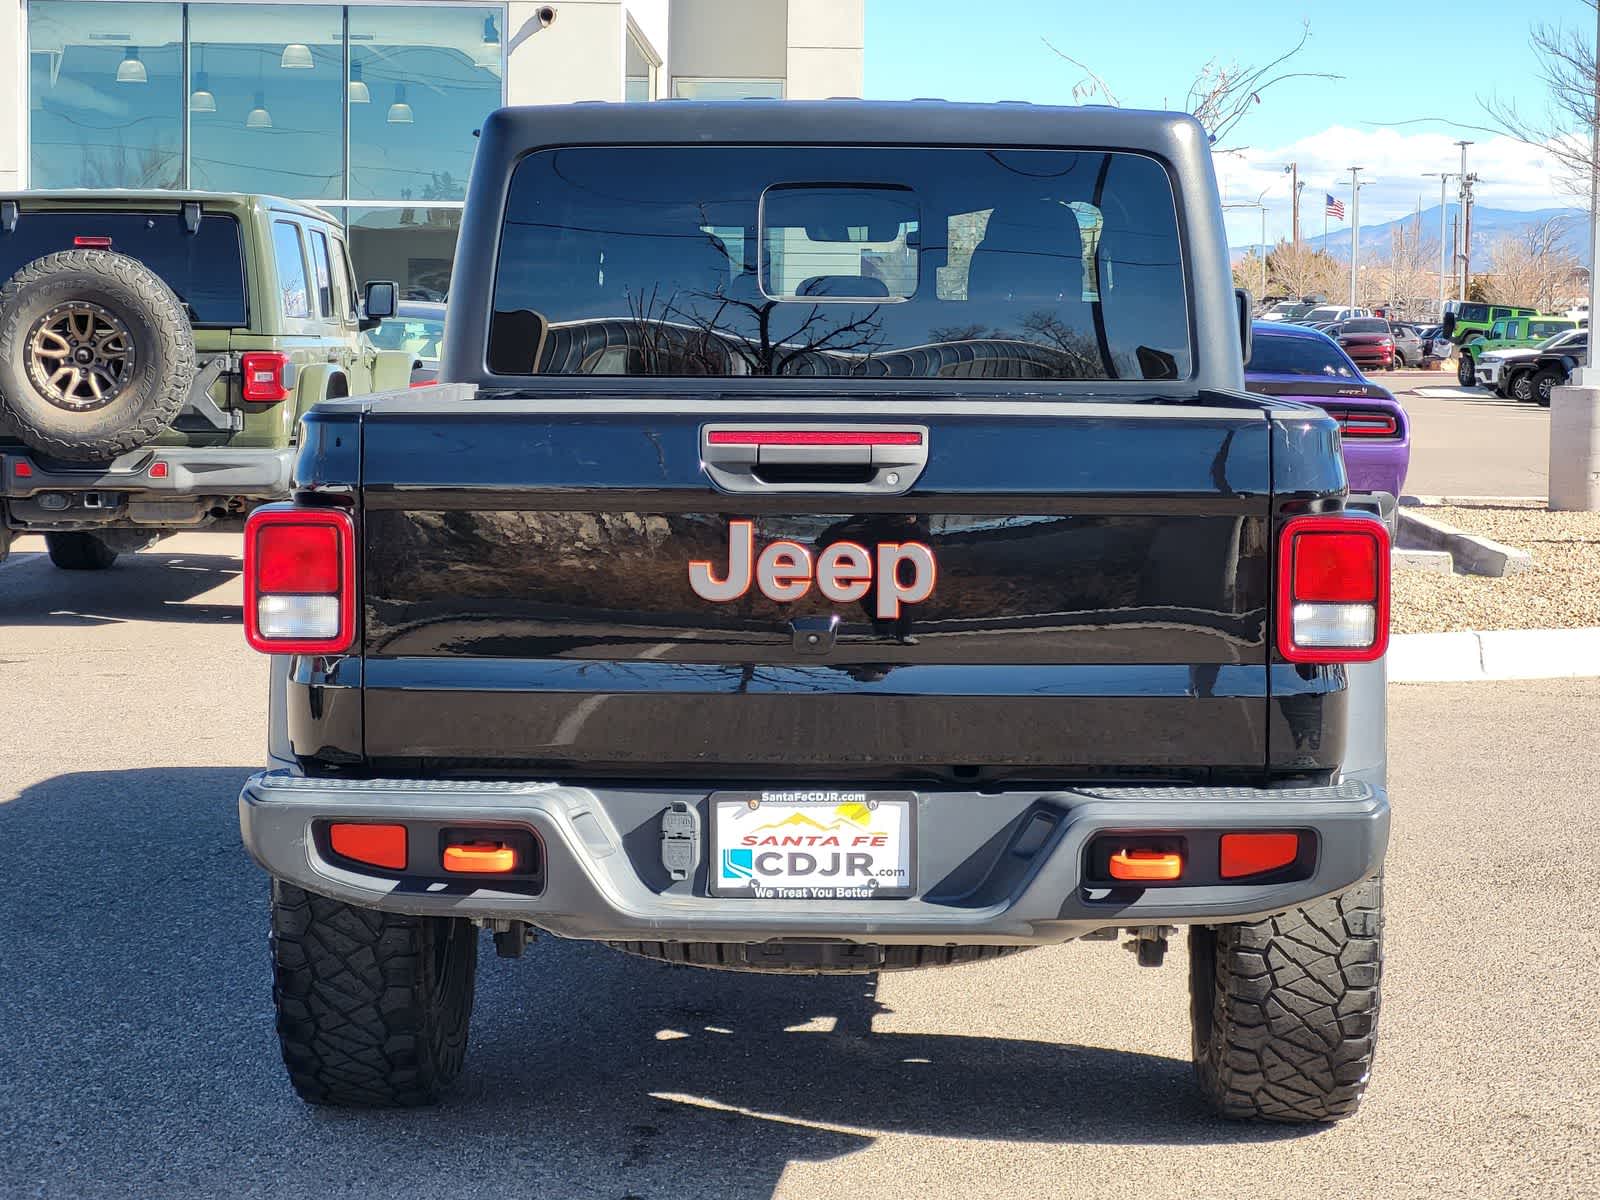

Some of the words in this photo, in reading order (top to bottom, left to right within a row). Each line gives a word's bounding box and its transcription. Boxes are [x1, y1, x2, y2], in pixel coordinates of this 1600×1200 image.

[688, 520, 937, 620] Jeep
[762, 792, 865, 802] SantaFeCDJR.com
[741, 836, 840, 846] SANTA
[852, 836, 888, 846] FE
[754, 887, 774, 898] We
[776, 887, 808, 898] Treat
[809, 887, 833, 898] You
[836, 887, 874, 898] Better
